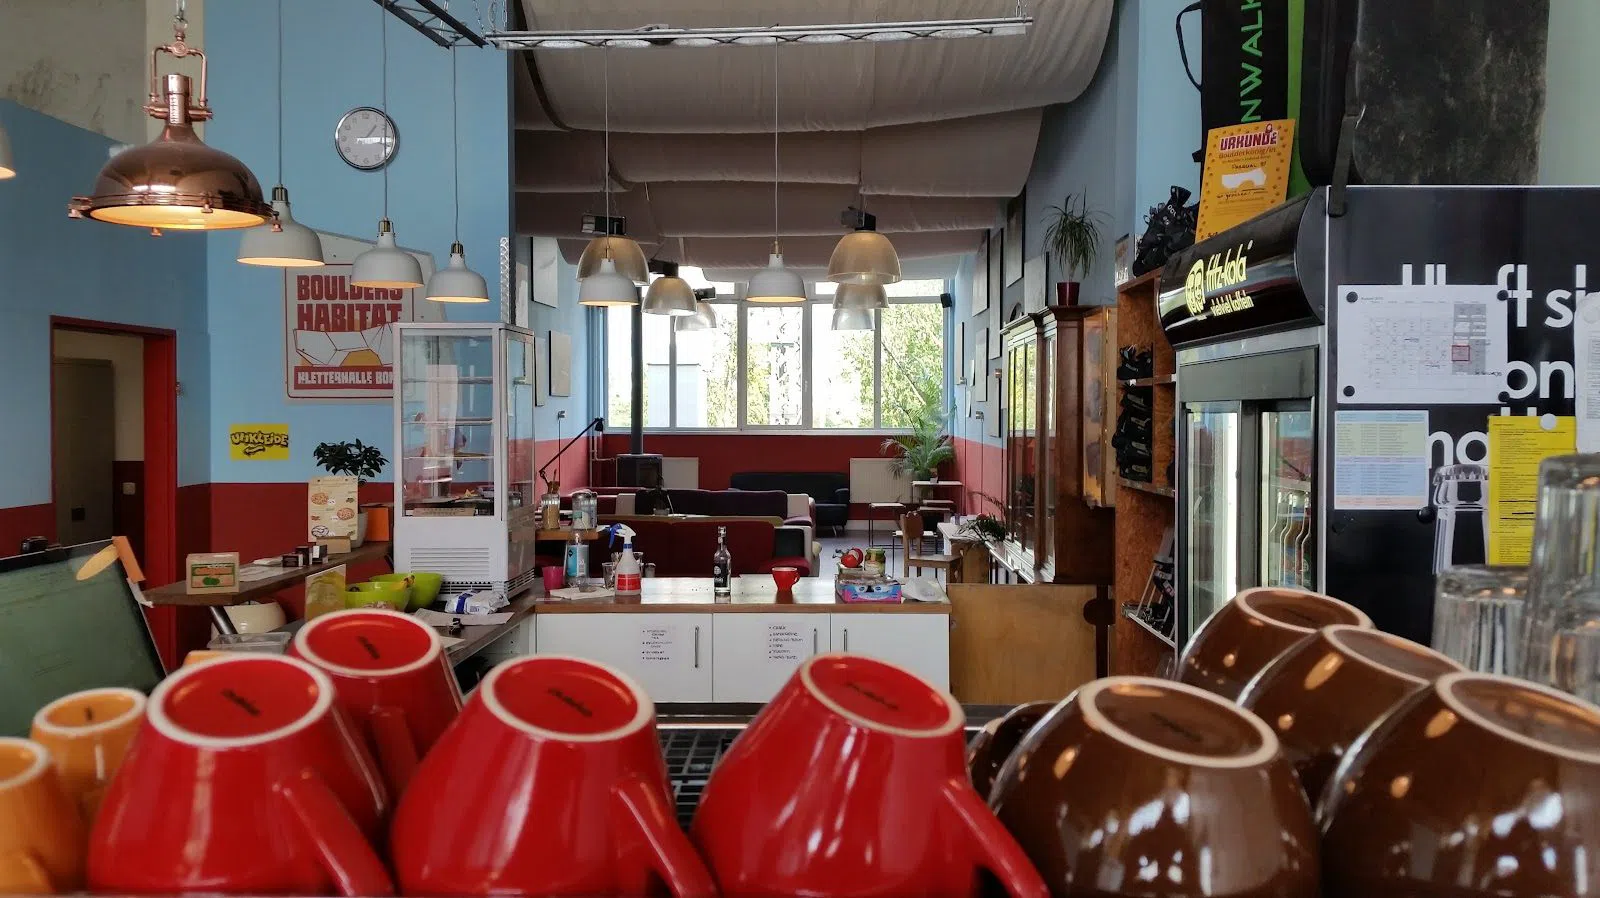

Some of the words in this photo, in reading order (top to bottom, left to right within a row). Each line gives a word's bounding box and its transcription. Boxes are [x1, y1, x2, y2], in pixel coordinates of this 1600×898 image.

[1220, 130, 1278, 151] URKUNDE
[296, 303, 403, 332] HABITAT
[297, 371, 373, 385] KLETTERHALLE
